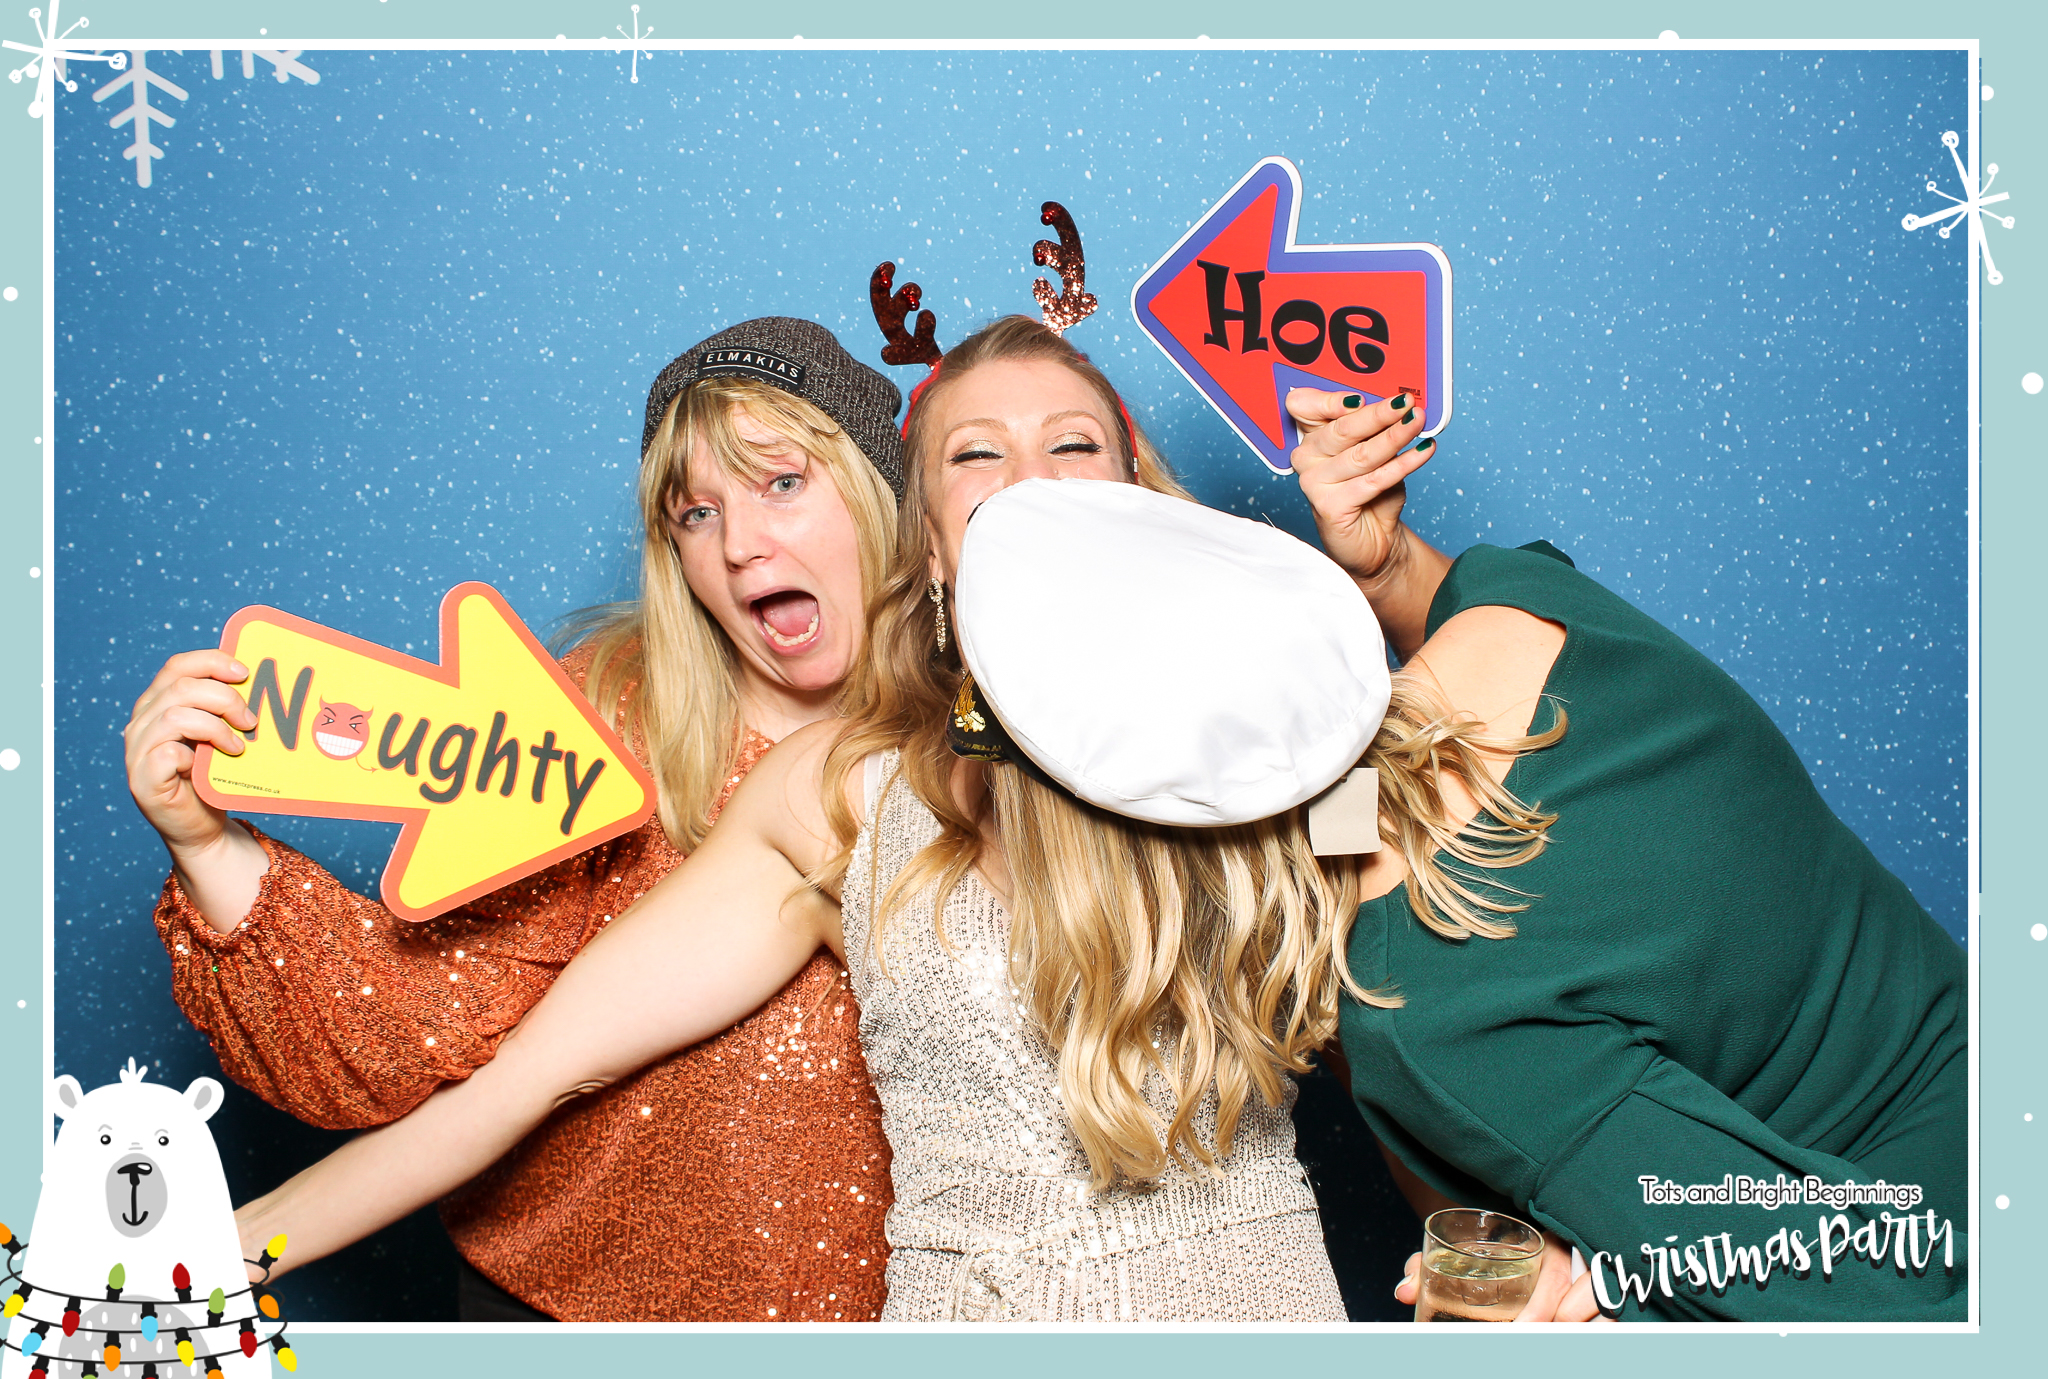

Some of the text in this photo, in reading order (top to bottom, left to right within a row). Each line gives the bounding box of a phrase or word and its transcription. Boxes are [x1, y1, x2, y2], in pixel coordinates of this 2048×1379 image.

[705, 351, 799, 378] ELMAKIAS
[1196, 259, 1390, 375] Hoe
[243, 657, 606, 836] Nughty
